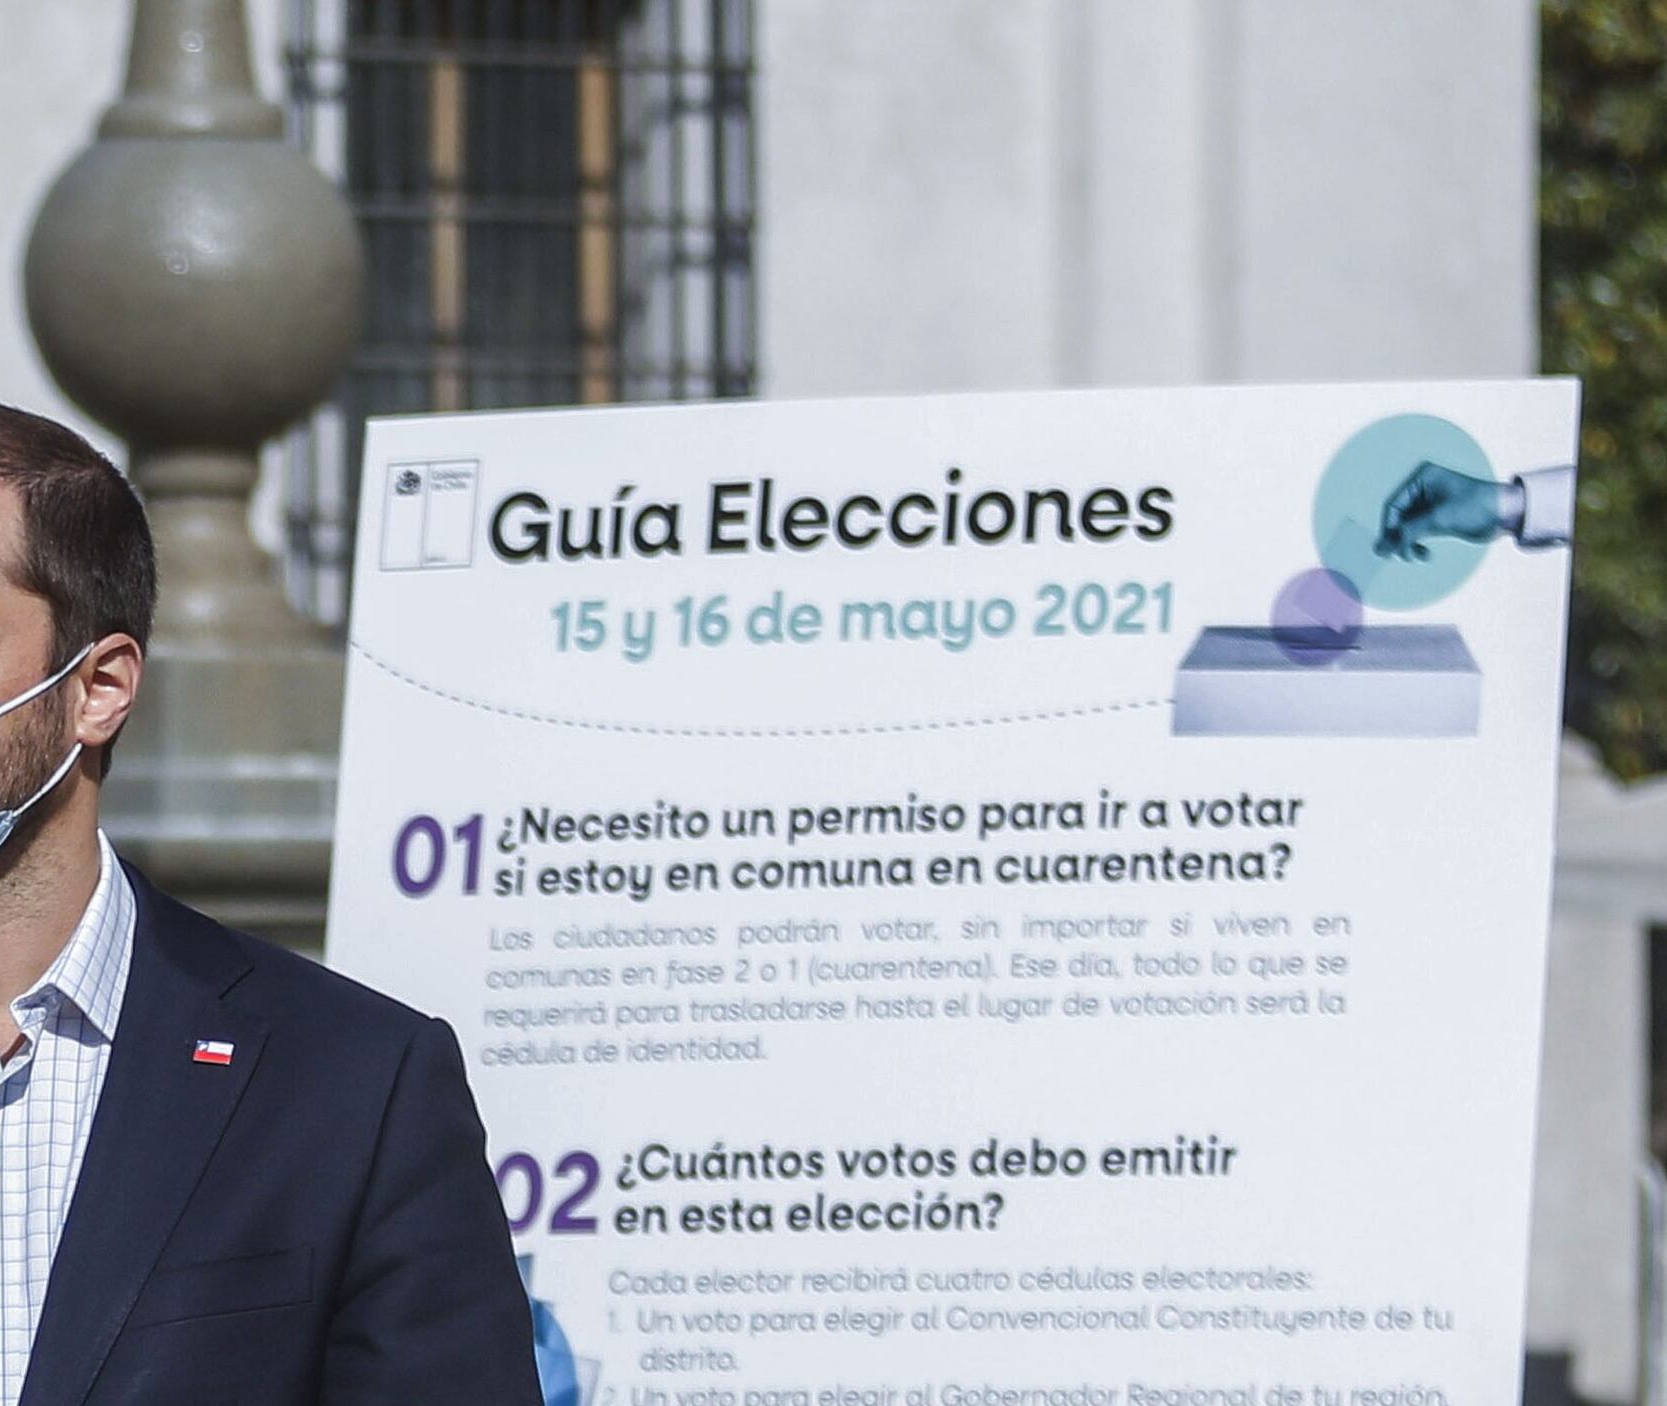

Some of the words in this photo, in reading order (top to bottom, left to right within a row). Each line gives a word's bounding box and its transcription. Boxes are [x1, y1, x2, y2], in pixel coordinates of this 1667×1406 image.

[488, 483, 683, 564] Guía
[706, 466, 1177, 553] Elecciones
[550, 600, 607, 653] 15
[621, 608, 657, 664] y
[671, 594, 731, 648] 16
[744, 590, 823, 645] de
[838, 597, 1017, 653] mayo
[1032, 580, 1176, 636] 2021
[390, 812, 485, 900] 01
[496, 802, 710, 854] ¿Necesito
[721, 809, 774, 837] un
[787, 797, 966, 845] permiso
[977, 802, 1086, 840] para
[1097, 793, 1127, 829] ir
[1139, 800, 1168, 828] a
[1181, 793, 1305, 827] votar
[493, 859, 526, 897] si
[536, 860, 653, 902] estoy
[665, 863, 720, 891] en
[730, 858, 914, 889] comuna
[926, 856, 982, 885] en
[994, 842, 1292, 883] cuarentena?
[493, 1149, 602, 1237] 02
[614, 1142, 826, 1191] ¿Cuántos
[836, 1143, 958, 1178] votos
[968, 1138, 1087, 1177] debo
[1100, 1136, 1238, 1176] emitir
[613, 1205, 668, 1234] en
[679, 1198, 774, 1233] esta
[785, 1191, 1006, 1232] elección?
